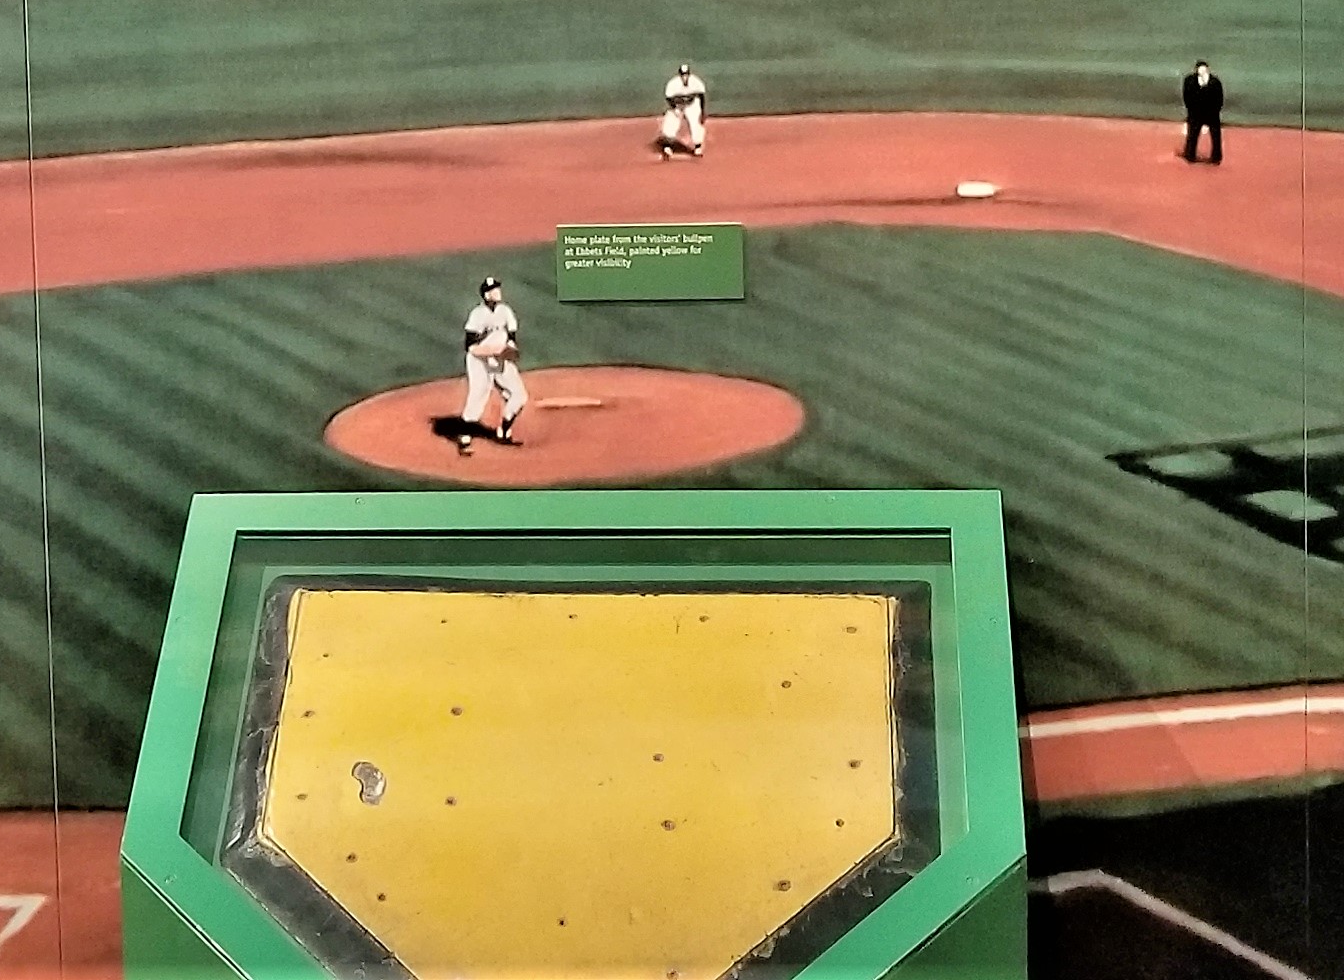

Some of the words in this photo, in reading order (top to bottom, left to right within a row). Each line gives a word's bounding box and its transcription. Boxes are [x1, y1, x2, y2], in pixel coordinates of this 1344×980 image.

[564, 235, 587, 244] Home
[589, 234, 610, 245] plate
[612, 234, 631, 243] from
[633, 234, 647, 243] the
[682, 233, 713, 243] bullpen
[564, 247, 573, 256] at
[575, 246, 602, 255] Ebbets
[604, 246, 626, 256] Field,
[629, 245, 660, 256] painted
[661, 245, 688, 256] yellow
[690, 244, 701, 254] for
[564, 259, 594, 269] greater
[595, 258, 631, 268] visibility
